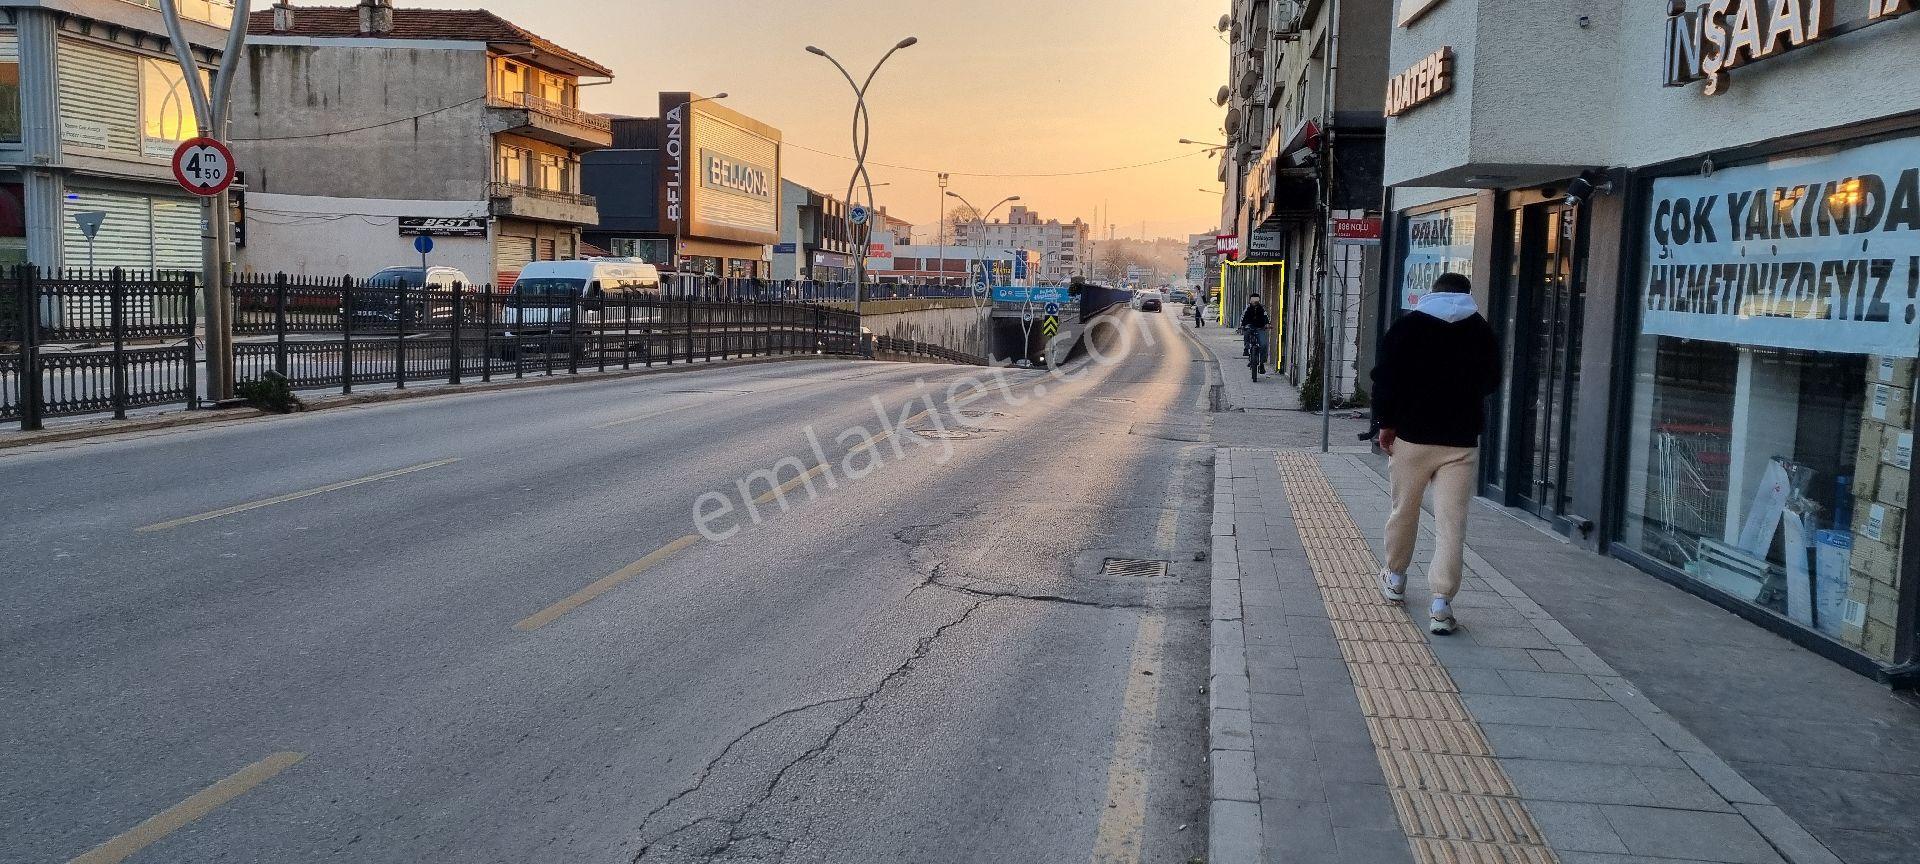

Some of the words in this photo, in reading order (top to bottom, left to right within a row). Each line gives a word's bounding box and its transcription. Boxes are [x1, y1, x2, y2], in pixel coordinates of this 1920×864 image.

[1384, 46, 1448, 117] ADATEPE
[186, 153, 201, 178] 4
[205, 154, 216, 162] m
[205, 169, 220, 179] 50
[667, 106, 682, 221] BELLONA
[709, 156, 768, 197] BELLONA
[1654, 194, 1718, 259] ÇOK
[1727, 168, 1920, 241] YAKINDA
